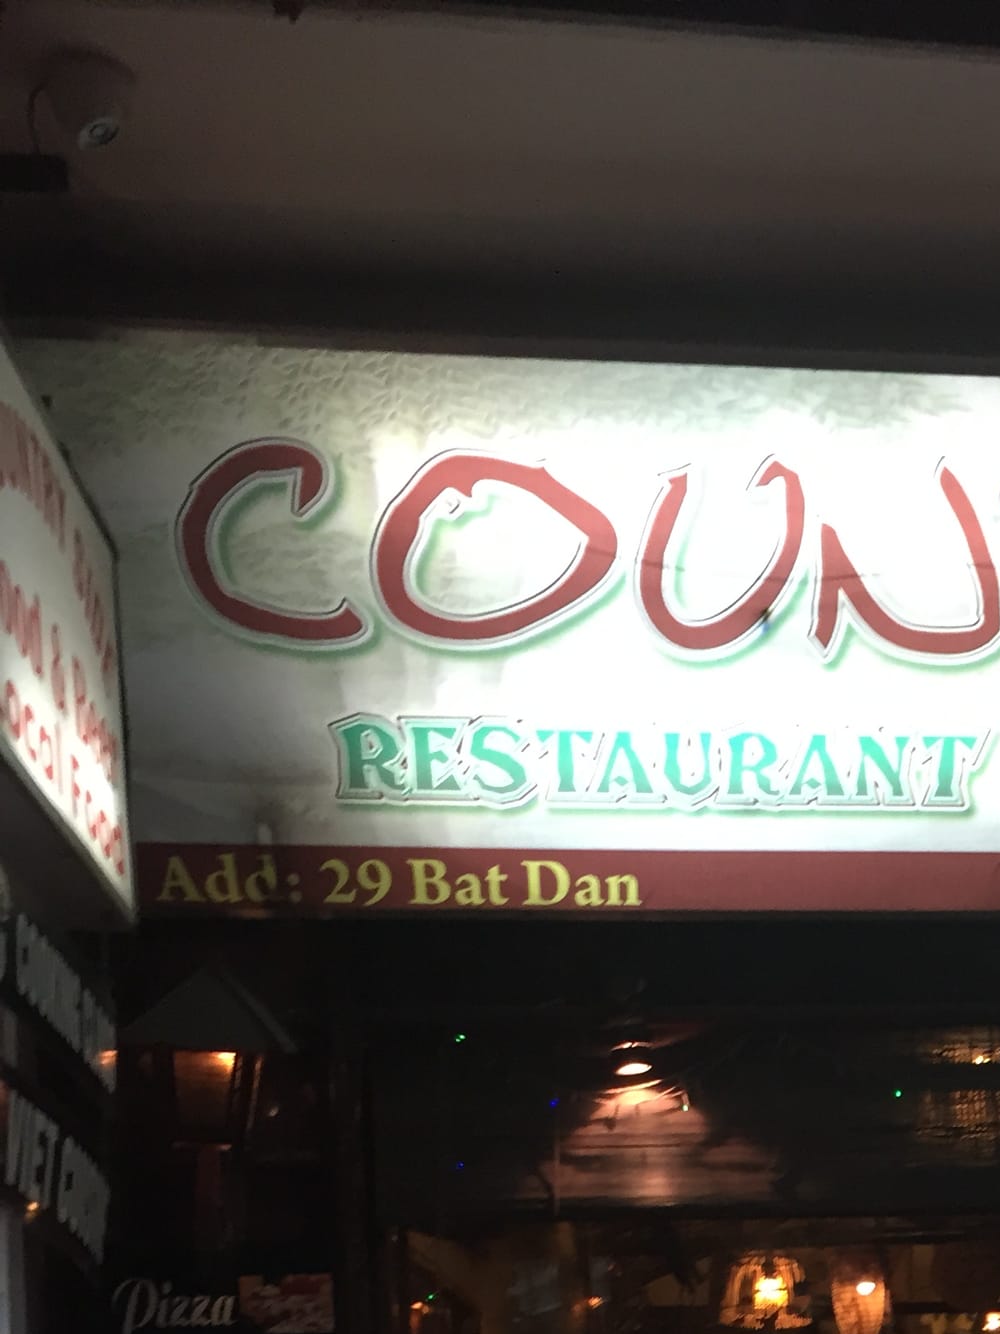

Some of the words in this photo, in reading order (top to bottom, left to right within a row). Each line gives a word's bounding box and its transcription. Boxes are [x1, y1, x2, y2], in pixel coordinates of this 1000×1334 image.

[0, 678, 63, 795] ocal
[330, 712, 986, 811] RESTAURANT
[158, 854, 302, 907] Add:
[322, 857, 392, 907] 29
[409, 860, 508, 907] Bat
[521, 860, 643, 908] Dan
